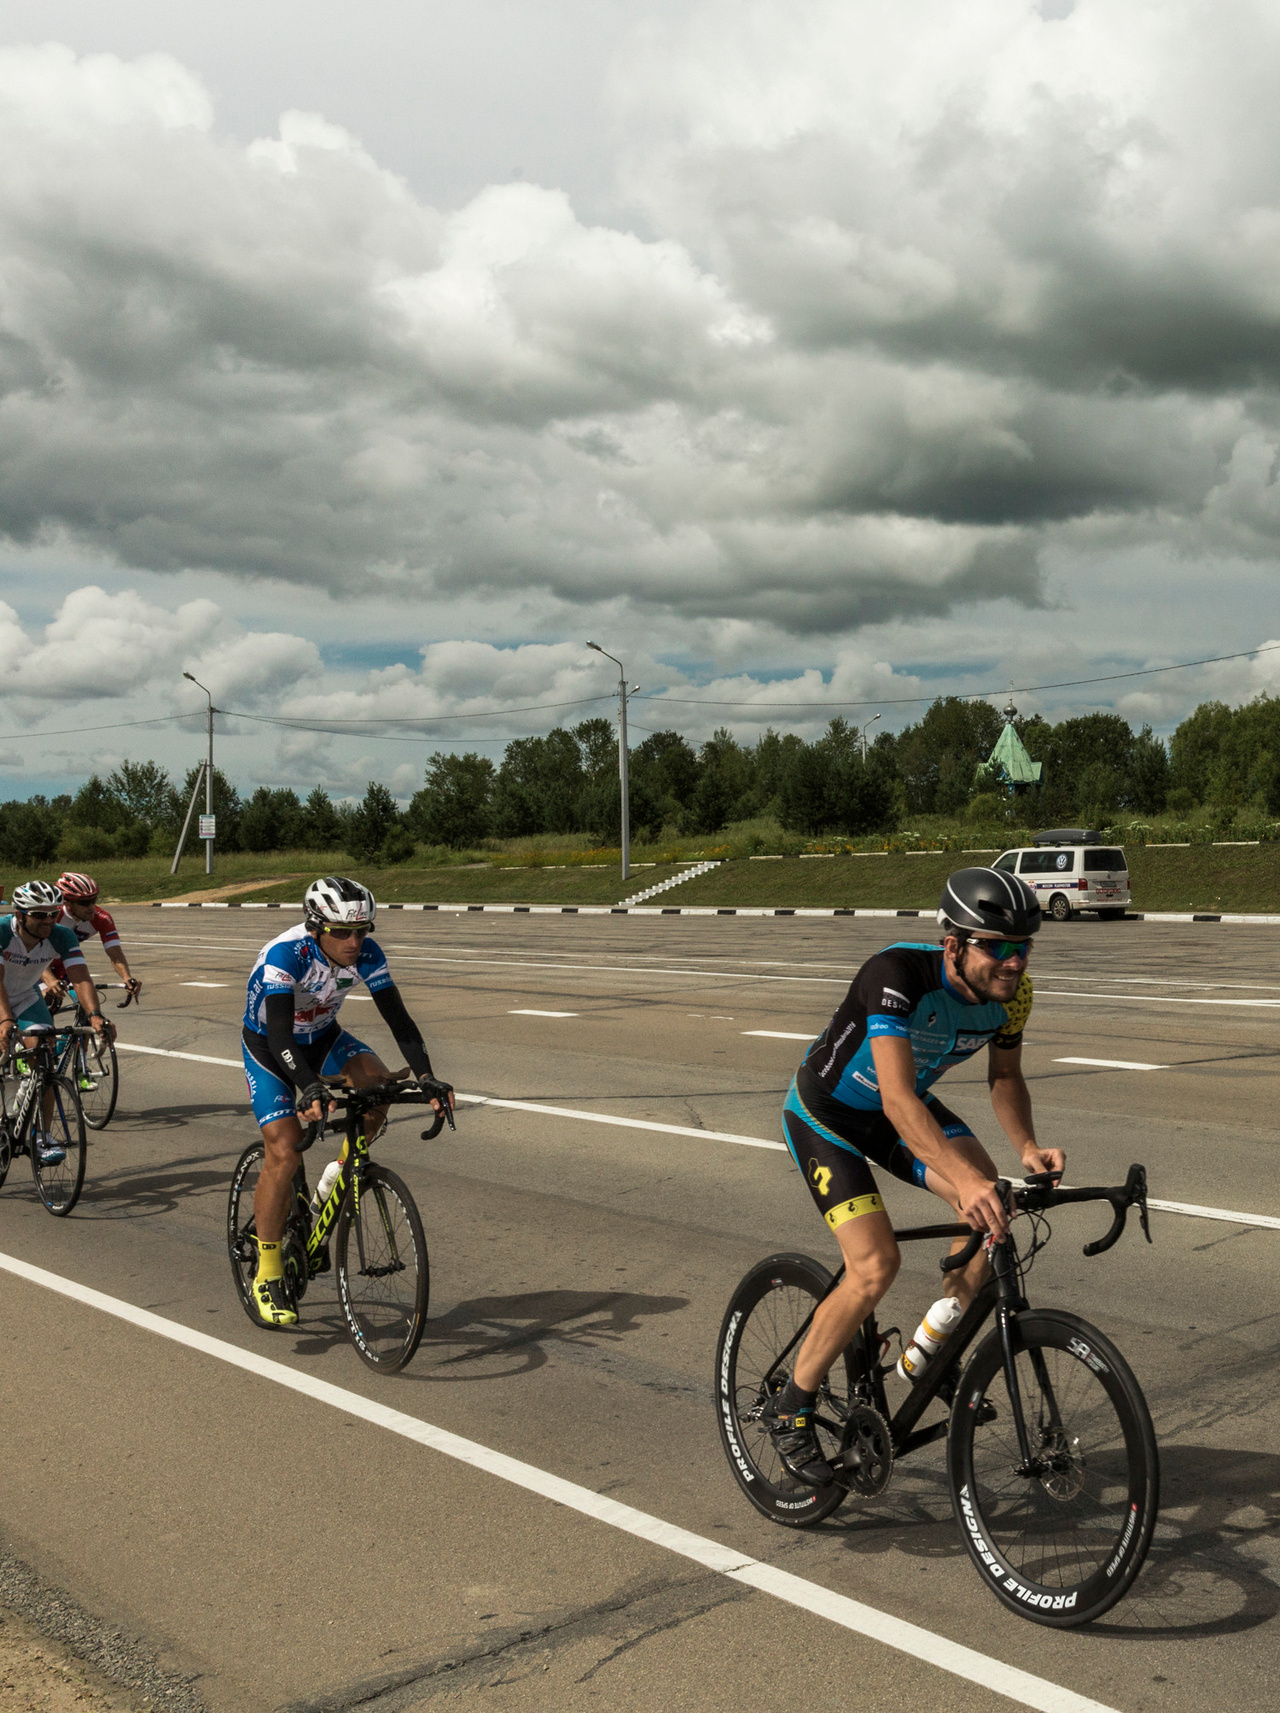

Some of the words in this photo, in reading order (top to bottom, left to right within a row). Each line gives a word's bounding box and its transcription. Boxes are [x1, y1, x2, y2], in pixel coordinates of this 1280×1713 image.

[955, 1037, 989, 1051] SAP
[306, 1168, 346, 1257] SCOTT
[720, 1314, 741, 1396] DESIGN
[721, 1398, 755, 1483] PROFILE
[960, 1497, 1006, 1578] DESIGN
[1002, 1577, 1078, 1609] PROFILE
